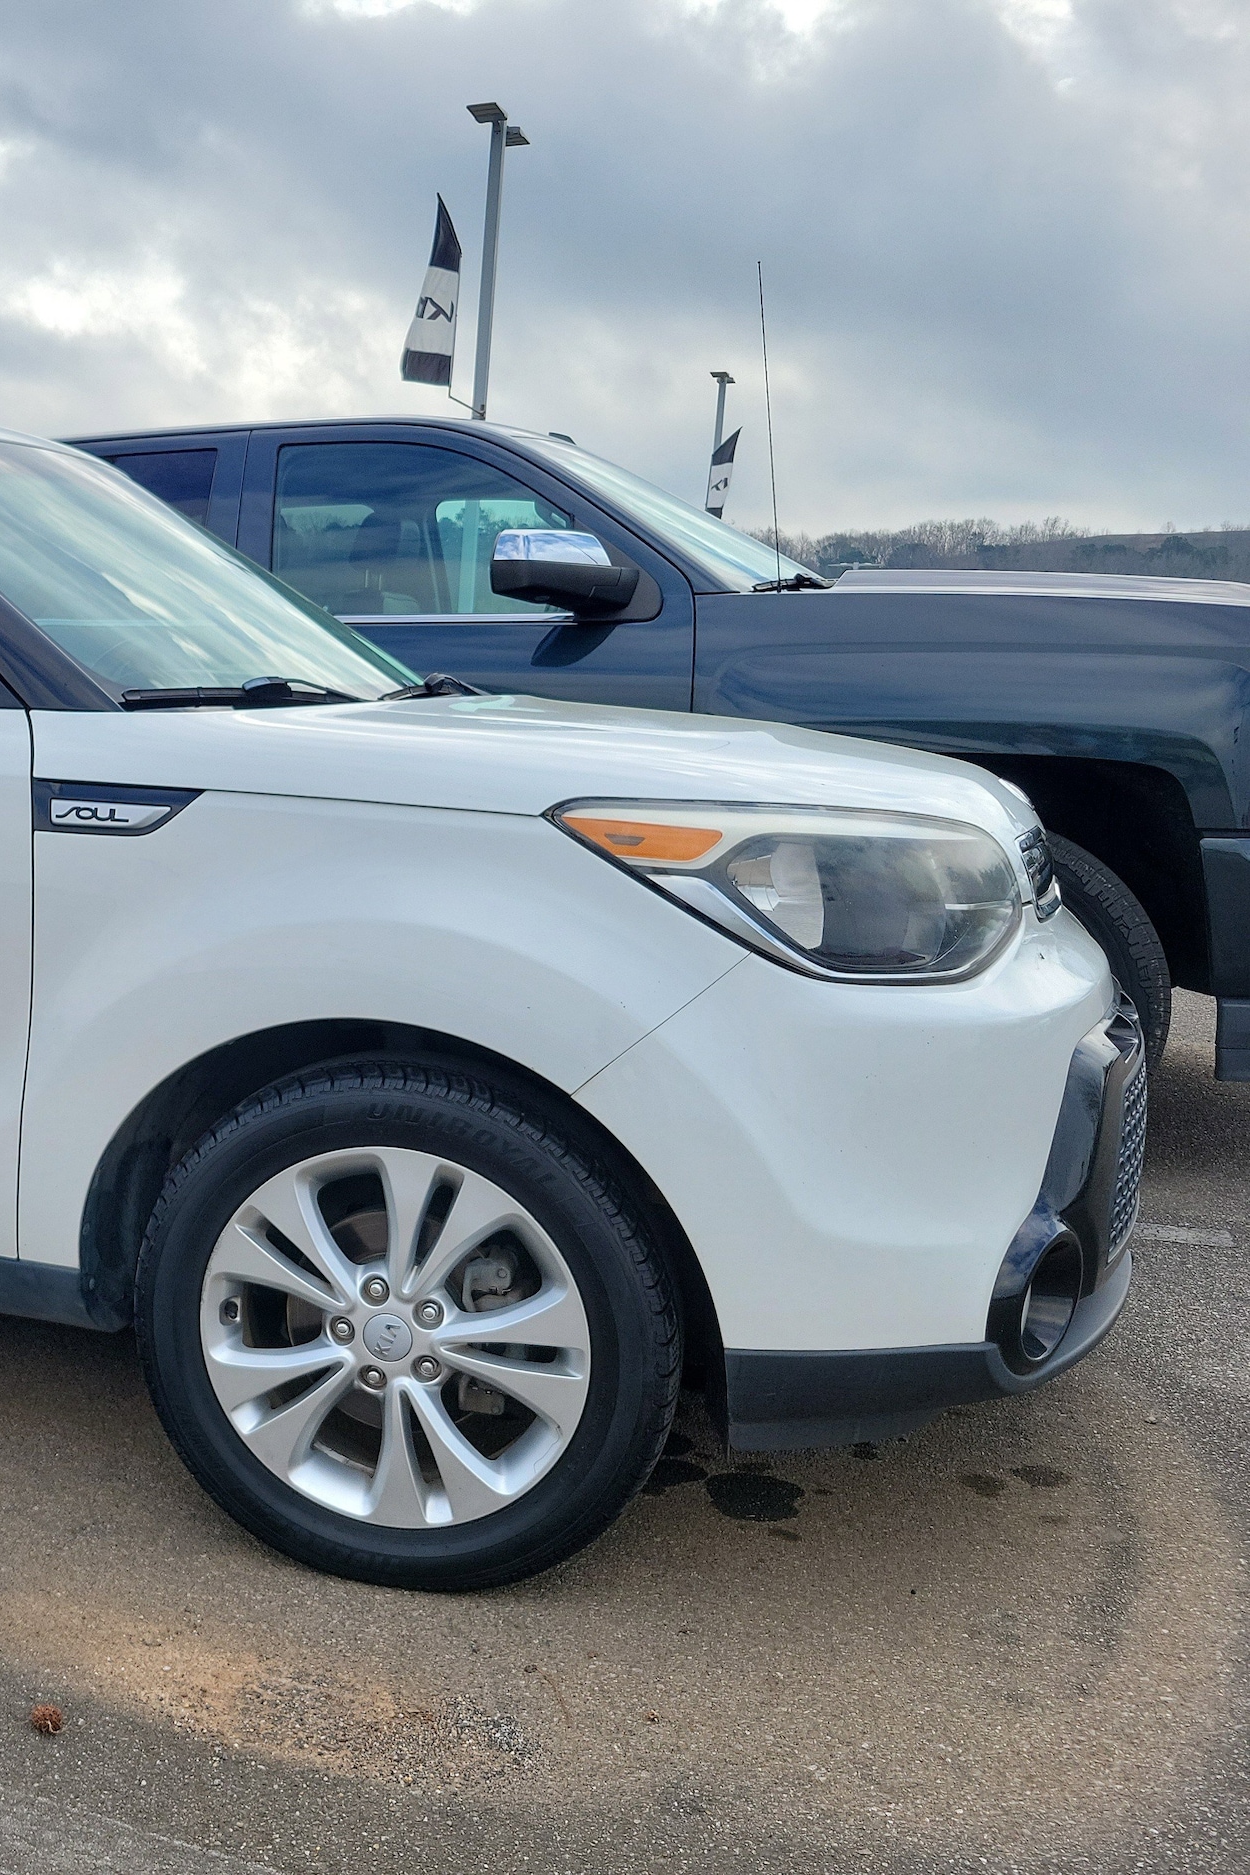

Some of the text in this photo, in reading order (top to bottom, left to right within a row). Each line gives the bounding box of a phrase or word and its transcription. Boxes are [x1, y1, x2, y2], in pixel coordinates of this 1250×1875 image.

[55, 806, 129, 823] SOUL
[366, 1102, 559, 1186] UNIROYAL
[374, 1322, 401, 1357] KIA
